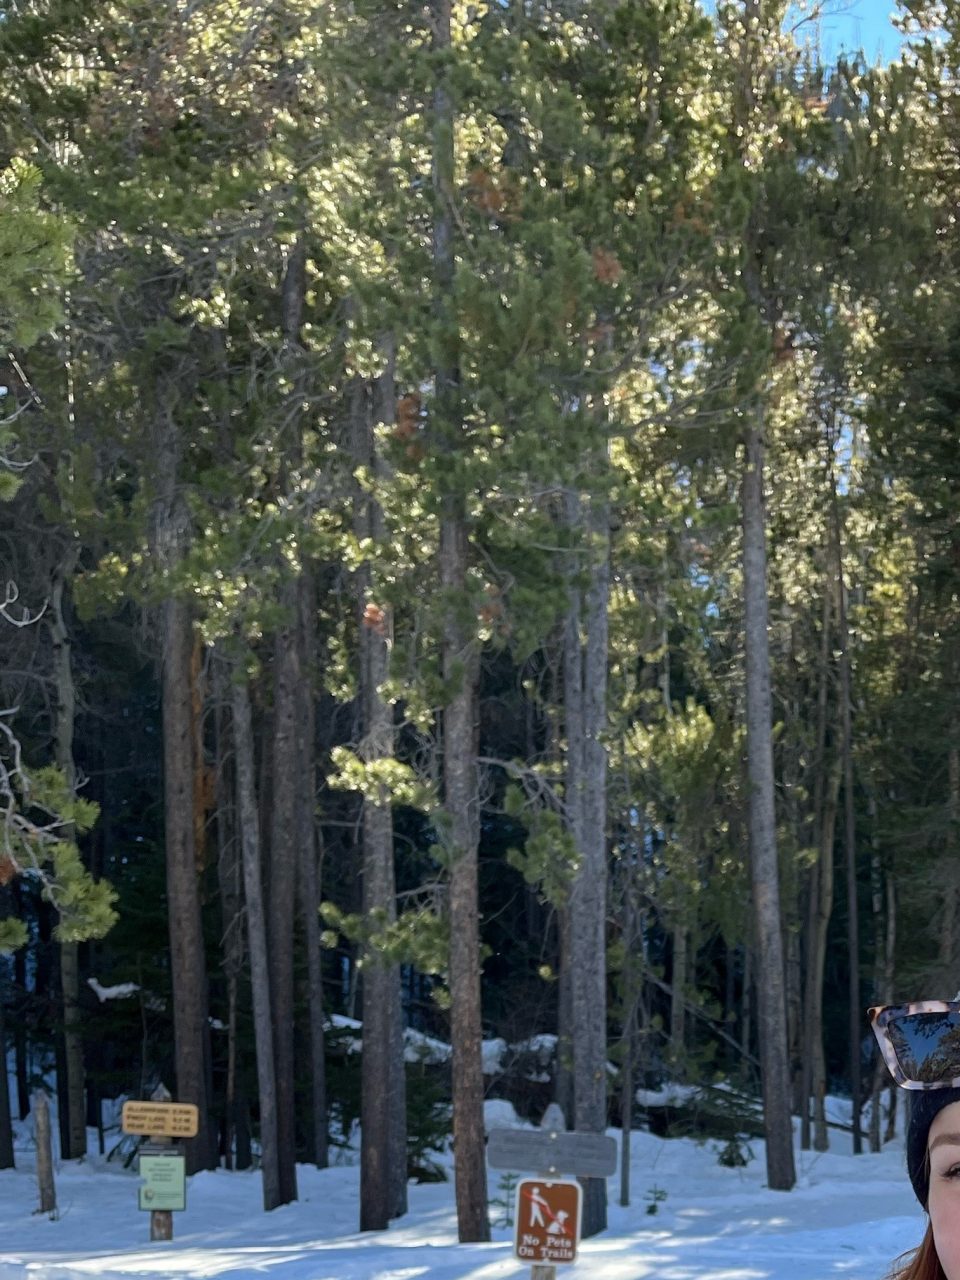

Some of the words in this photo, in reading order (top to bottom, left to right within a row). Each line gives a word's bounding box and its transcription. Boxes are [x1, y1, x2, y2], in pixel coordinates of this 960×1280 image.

[523, 1234, 540, 1246] No
[546, 1236, 572, 1248] Pets
[519, 1246, 535, 1257] On
[540, 1247, 573, 1259] Trails
